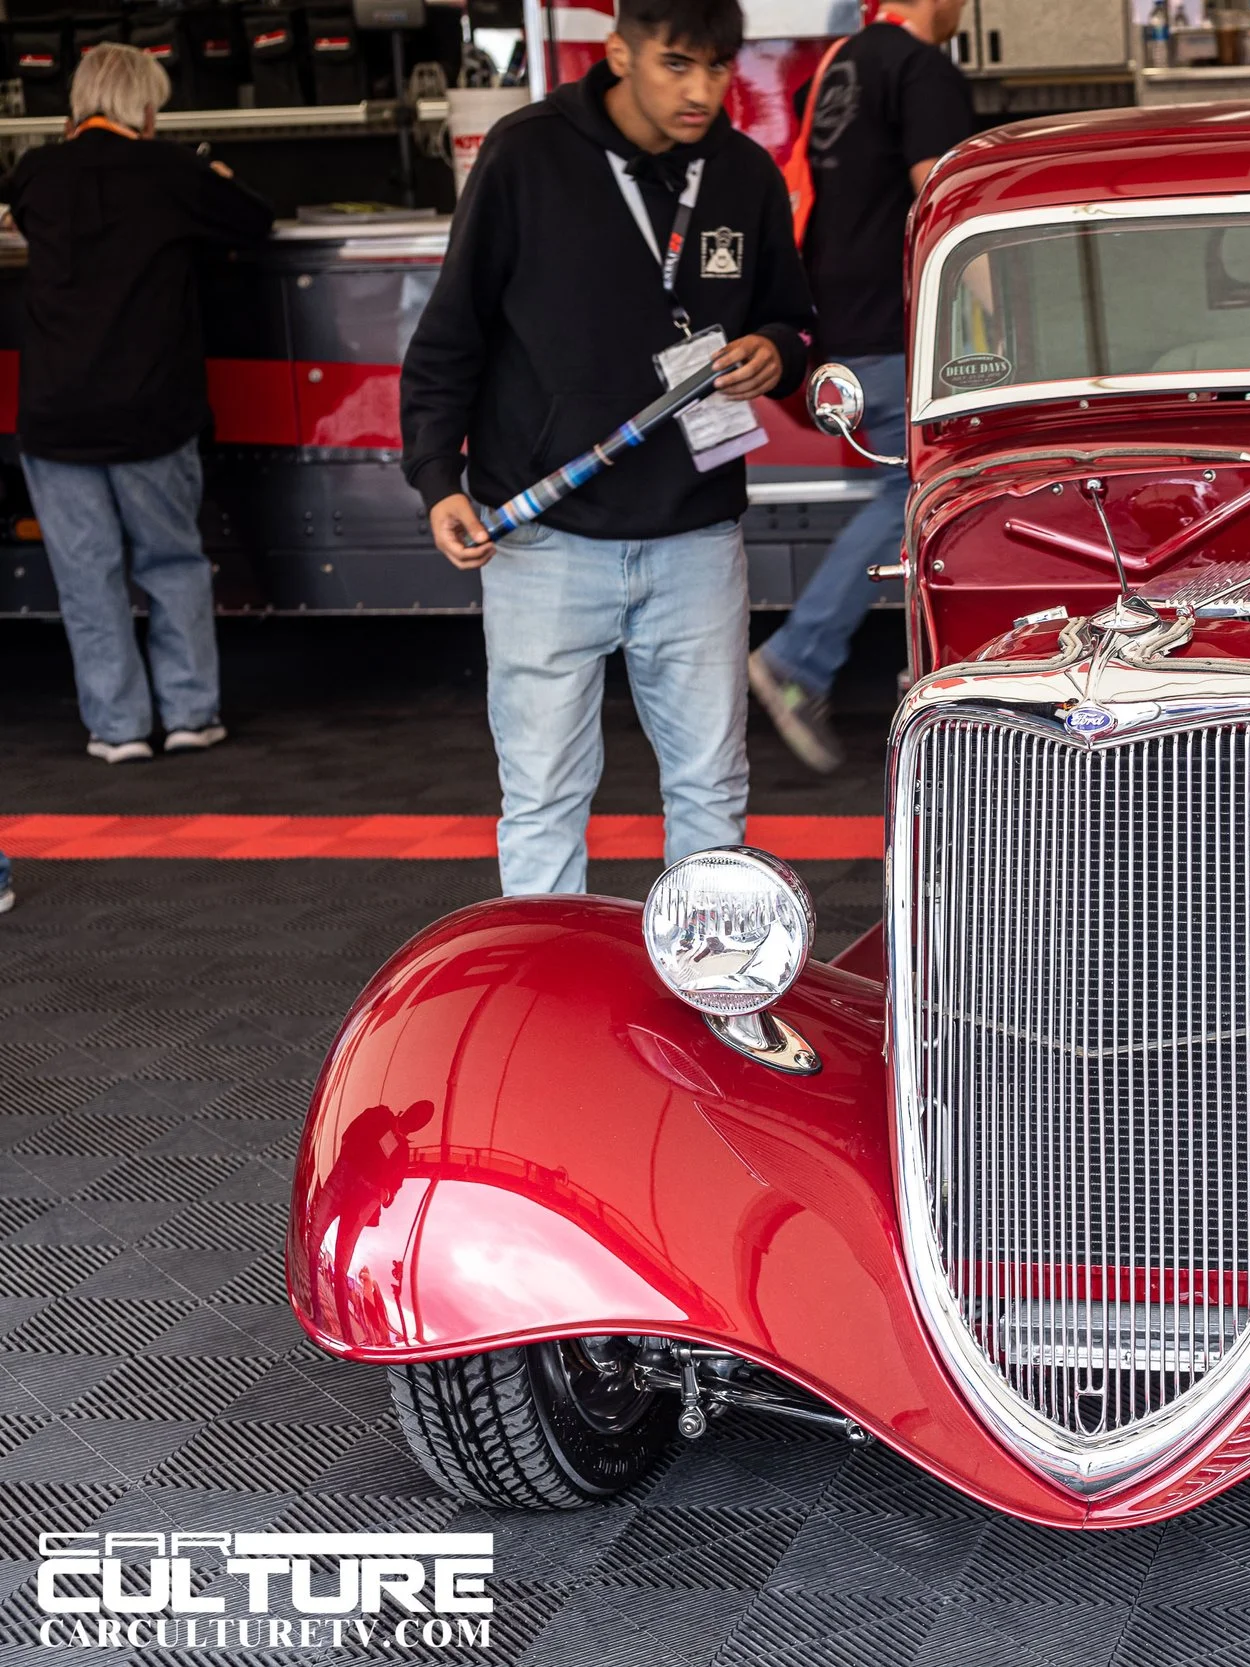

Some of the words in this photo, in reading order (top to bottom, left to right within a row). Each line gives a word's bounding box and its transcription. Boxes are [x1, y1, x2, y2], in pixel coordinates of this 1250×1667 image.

[946, 364, 976, 377] DEUCE
[980, 361, 1007, 374] DAYS
[1070, 712, 1105, 726] Ford
